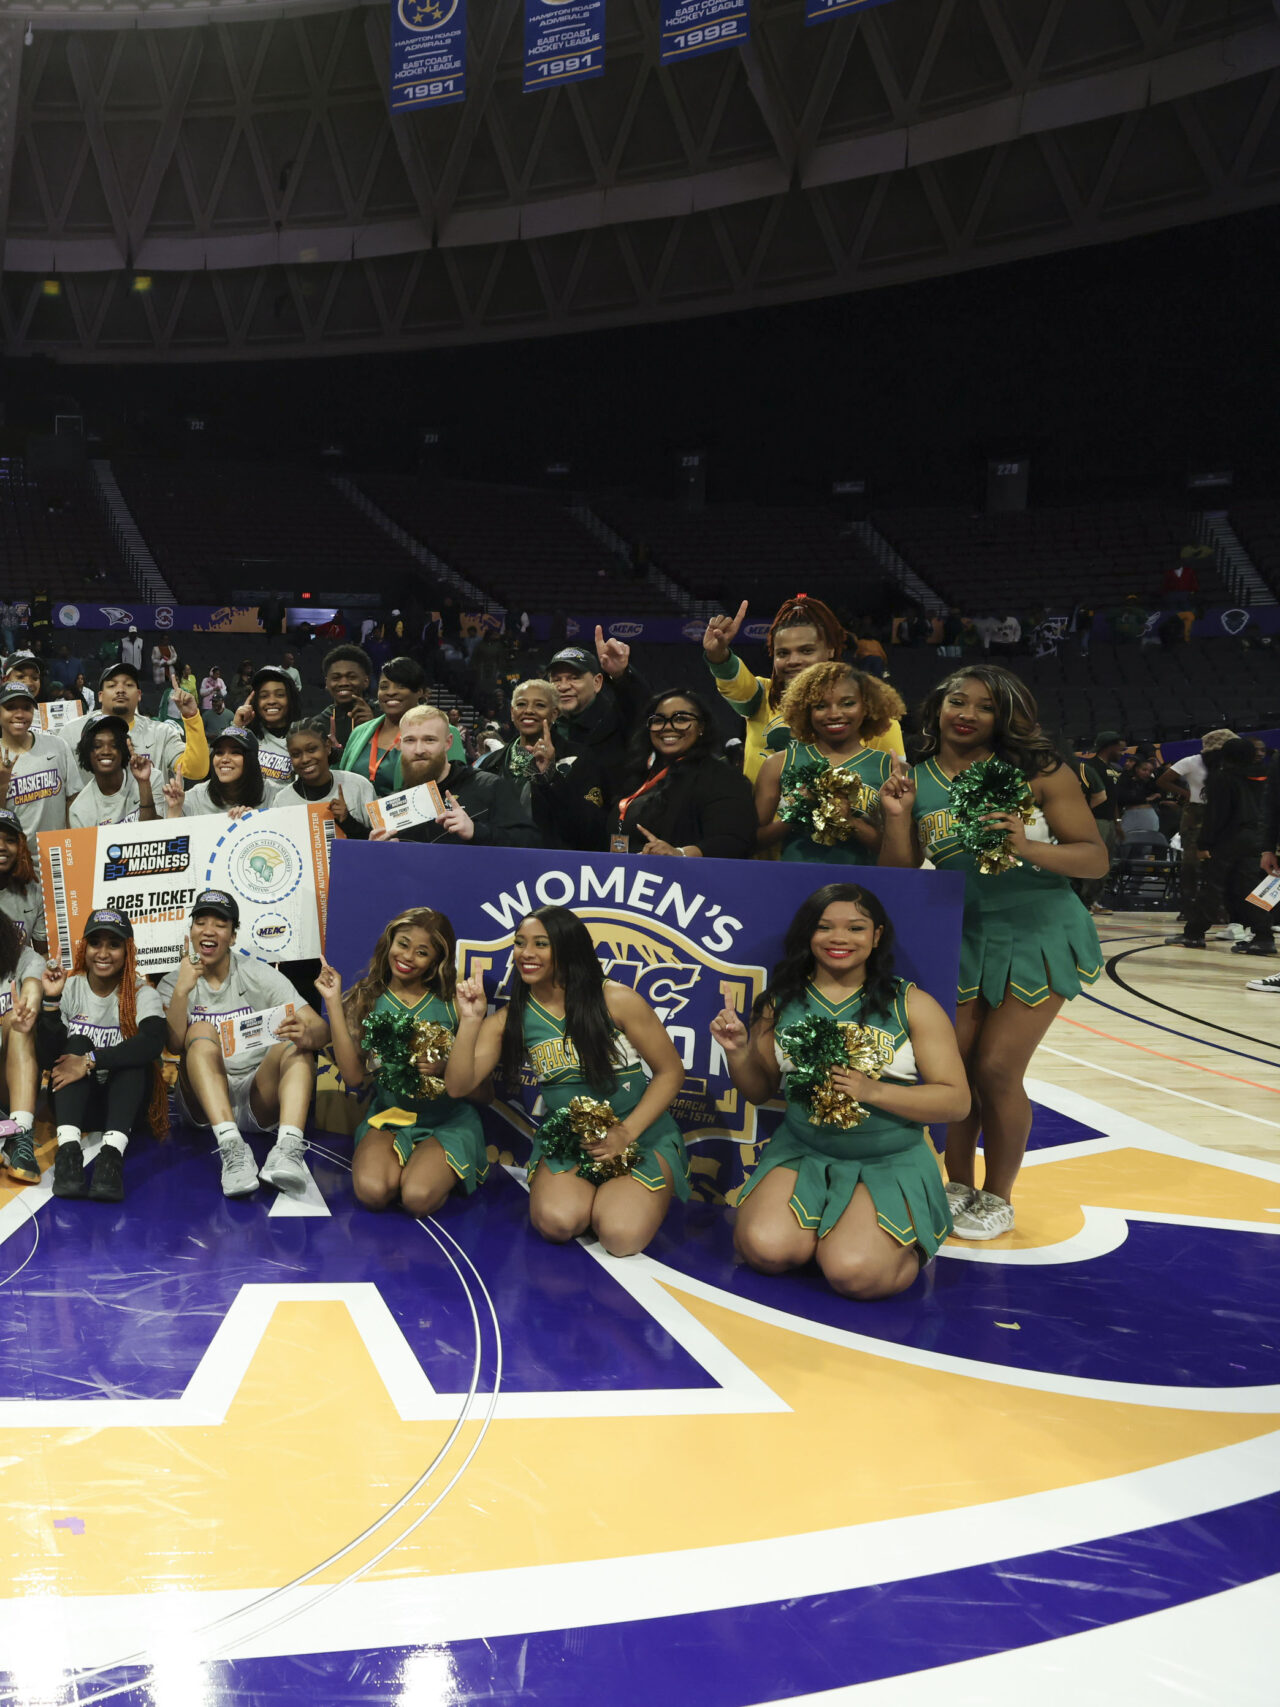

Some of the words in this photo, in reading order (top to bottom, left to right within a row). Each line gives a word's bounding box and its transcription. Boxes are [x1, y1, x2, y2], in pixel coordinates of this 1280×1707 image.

[528, 10, 570, 23] HAMPTON
[571, 2, 601, 14] ROADS
[538, 12, 590, 28] ADMIRALS
[665, 11, 704, 27] HOCKEY
[705, 0, 745, 17] LEAGUE
[675, 5, 701, 17] EAST
[394, 35, 432, 47] HAMPTON
[433, 30, 462, 39] ROADS
[536, 36, 560, 47] EAST
[560, 29, 591, 43] COAST
[674, 21, 738, 48] 1992
[404, 38, 451, 52] ADMIRALS
[527, 42, 559, 56] HOCKEY
[560, 33, 600, 49] LEAGUE
[394, 66, 428, 79] HOCKEY
[429, 60, 462, 73] LEAGUE
[402, 60, 424, 70] EAST
[425, 55, 454, 67] COAST
[538, 55, 592, 77] 1991
[403, 80, 455, 100] 1991
[611, 624, 642, 635] MEAC
[17, 771, 58, 795] BASKETBALL
[14, 788, 53, 806] CHAMPIONS
[311, 813, 323, 849] QUALIFIER
[64, 838, 72, 848] 25
[121, 841, 167, 859] MARCH
[66, 852, 74, 866] SEAT
[128, 854, 189, 872] MADNESS
[315, 849, 326, 889] AUTOMATIC
[106, 895, 144, 910] 2025
[147, 888, 196, 907] TICKET
[480, 865, 743, 951] WOMEN'S
[71, 902, 79, 916] ROW
[127, 906, 186, 925] UNCHED
[258, 926, 287, 937] MEAC
